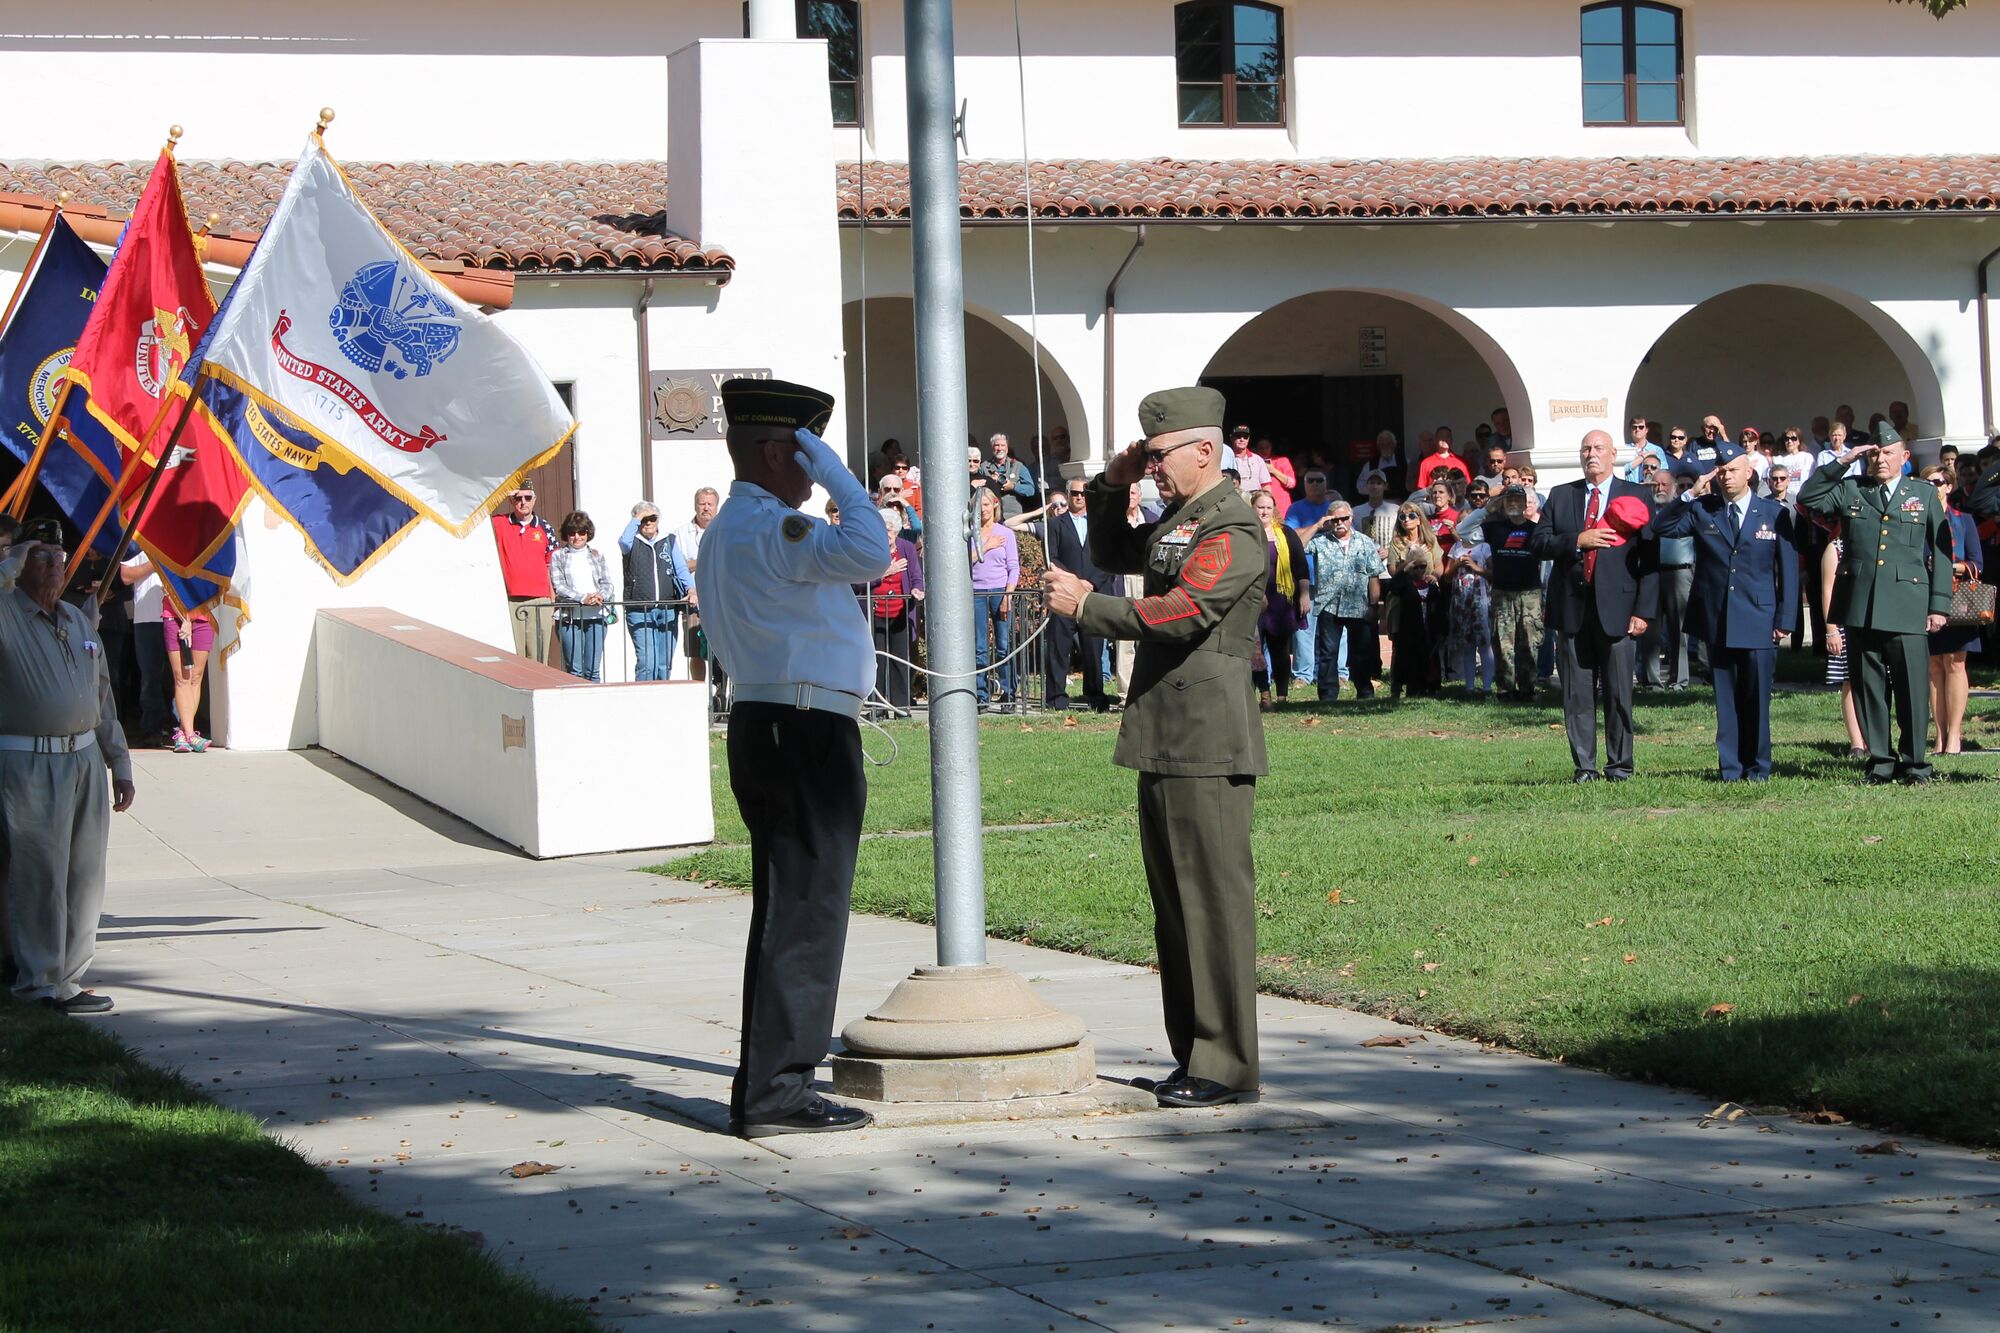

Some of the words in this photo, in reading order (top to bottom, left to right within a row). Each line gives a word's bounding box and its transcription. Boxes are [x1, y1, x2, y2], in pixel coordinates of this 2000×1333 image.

[138, 342, 158, 395] UNITED
[275, 347, 314, 378] UNITED
[316, 369, 367, 411] STATES
[364, 411, 413, 448] ARMY
[314, 391, 345, 421] 1775
[1552, 404, 1581, 414] LARGE
[1582, 404, 1605, 413] HALL
[751, 413, 797, 425] COMMANDER
[255, 422, 283, 451] STATES
[283, 446, 313, 465] NAVY
